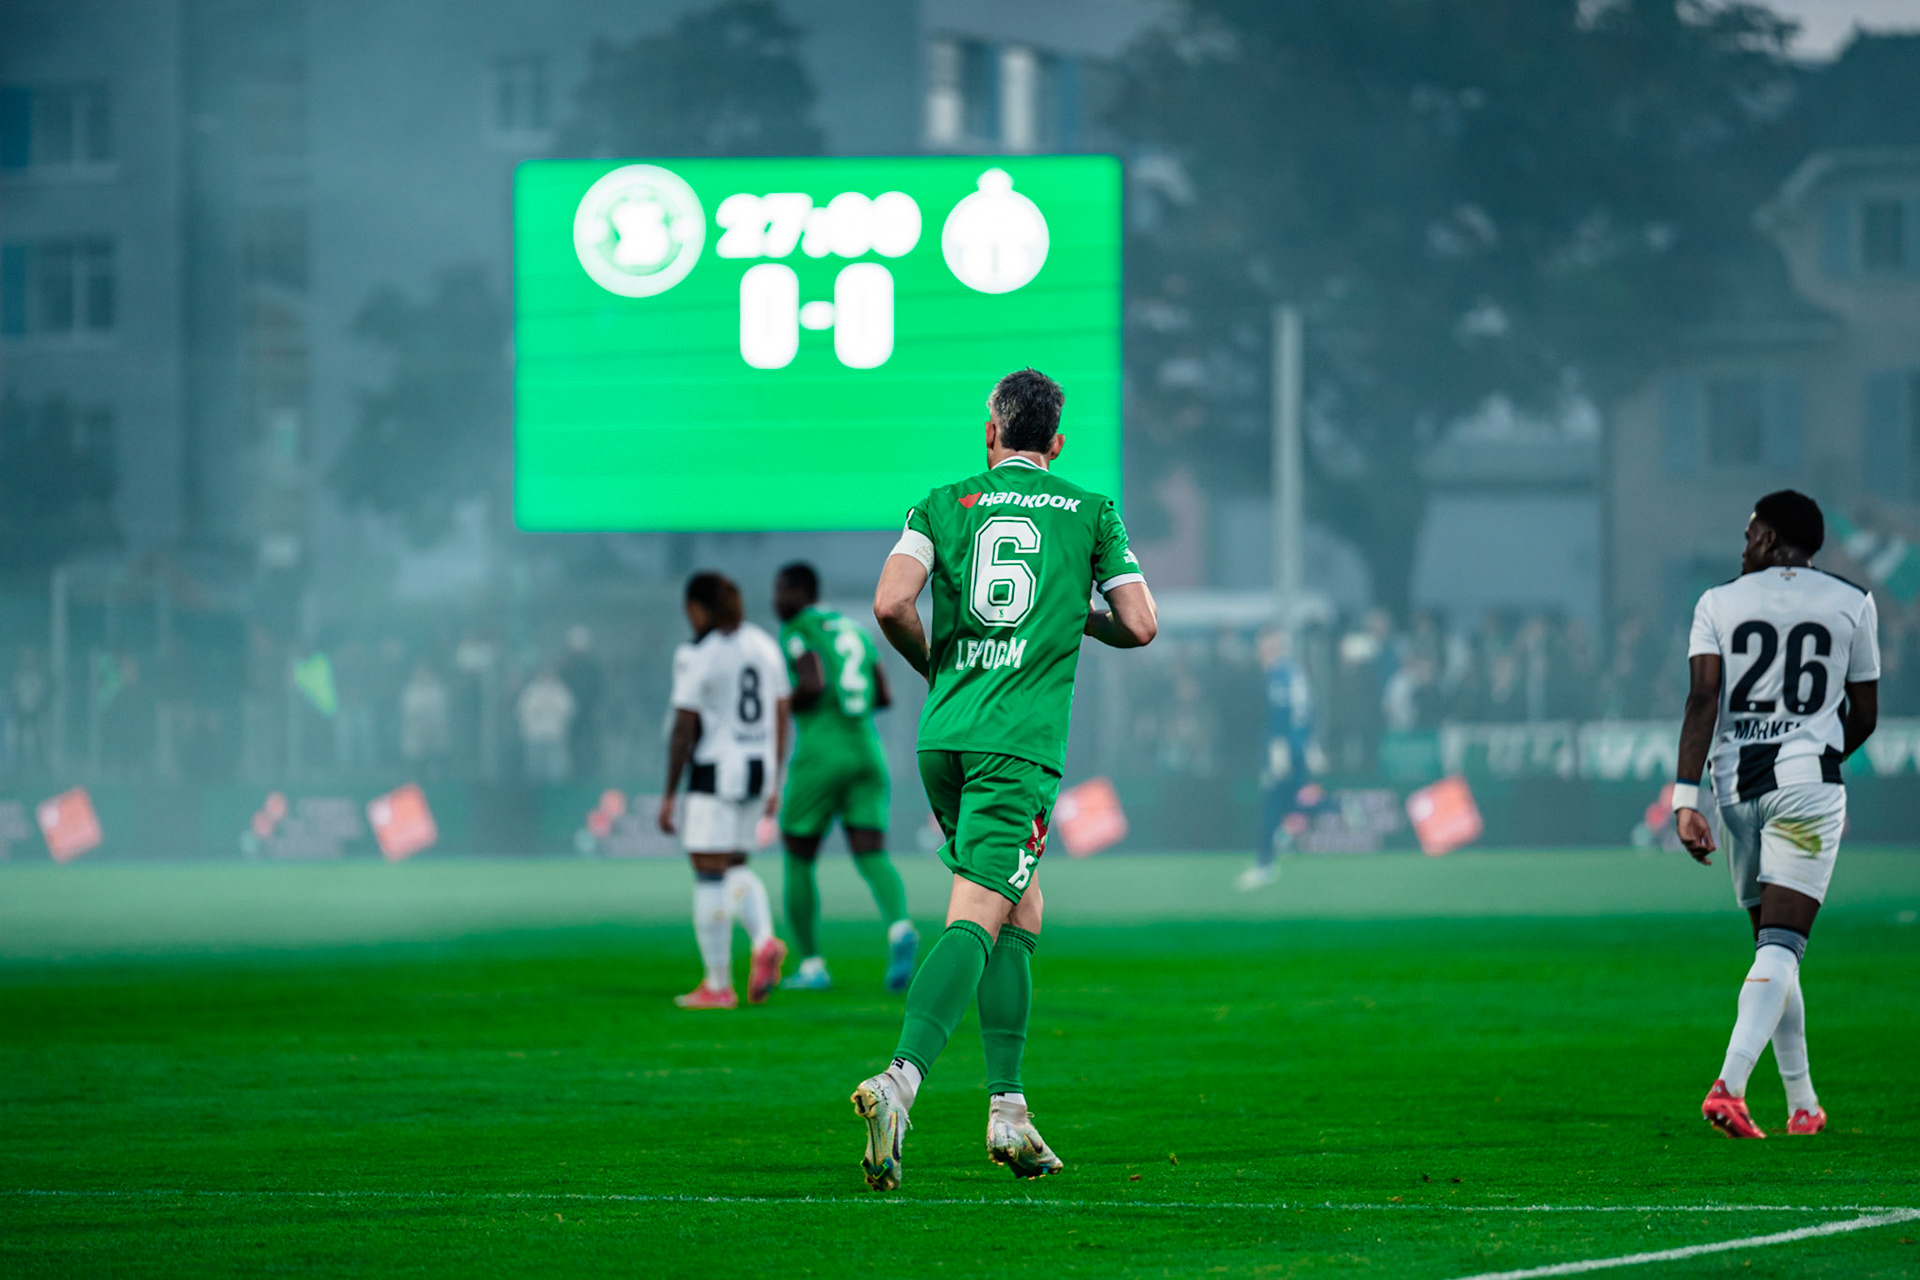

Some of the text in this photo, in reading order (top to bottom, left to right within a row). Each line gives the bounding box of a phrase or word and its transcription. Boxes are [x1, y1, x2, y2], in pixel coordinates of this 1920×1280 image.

[969, 516, 1041, 627] 6
[738, 666, 762, 724] 8
[834, 630, 869, 692] 2
[1729, 619, 1831, 715] 26
